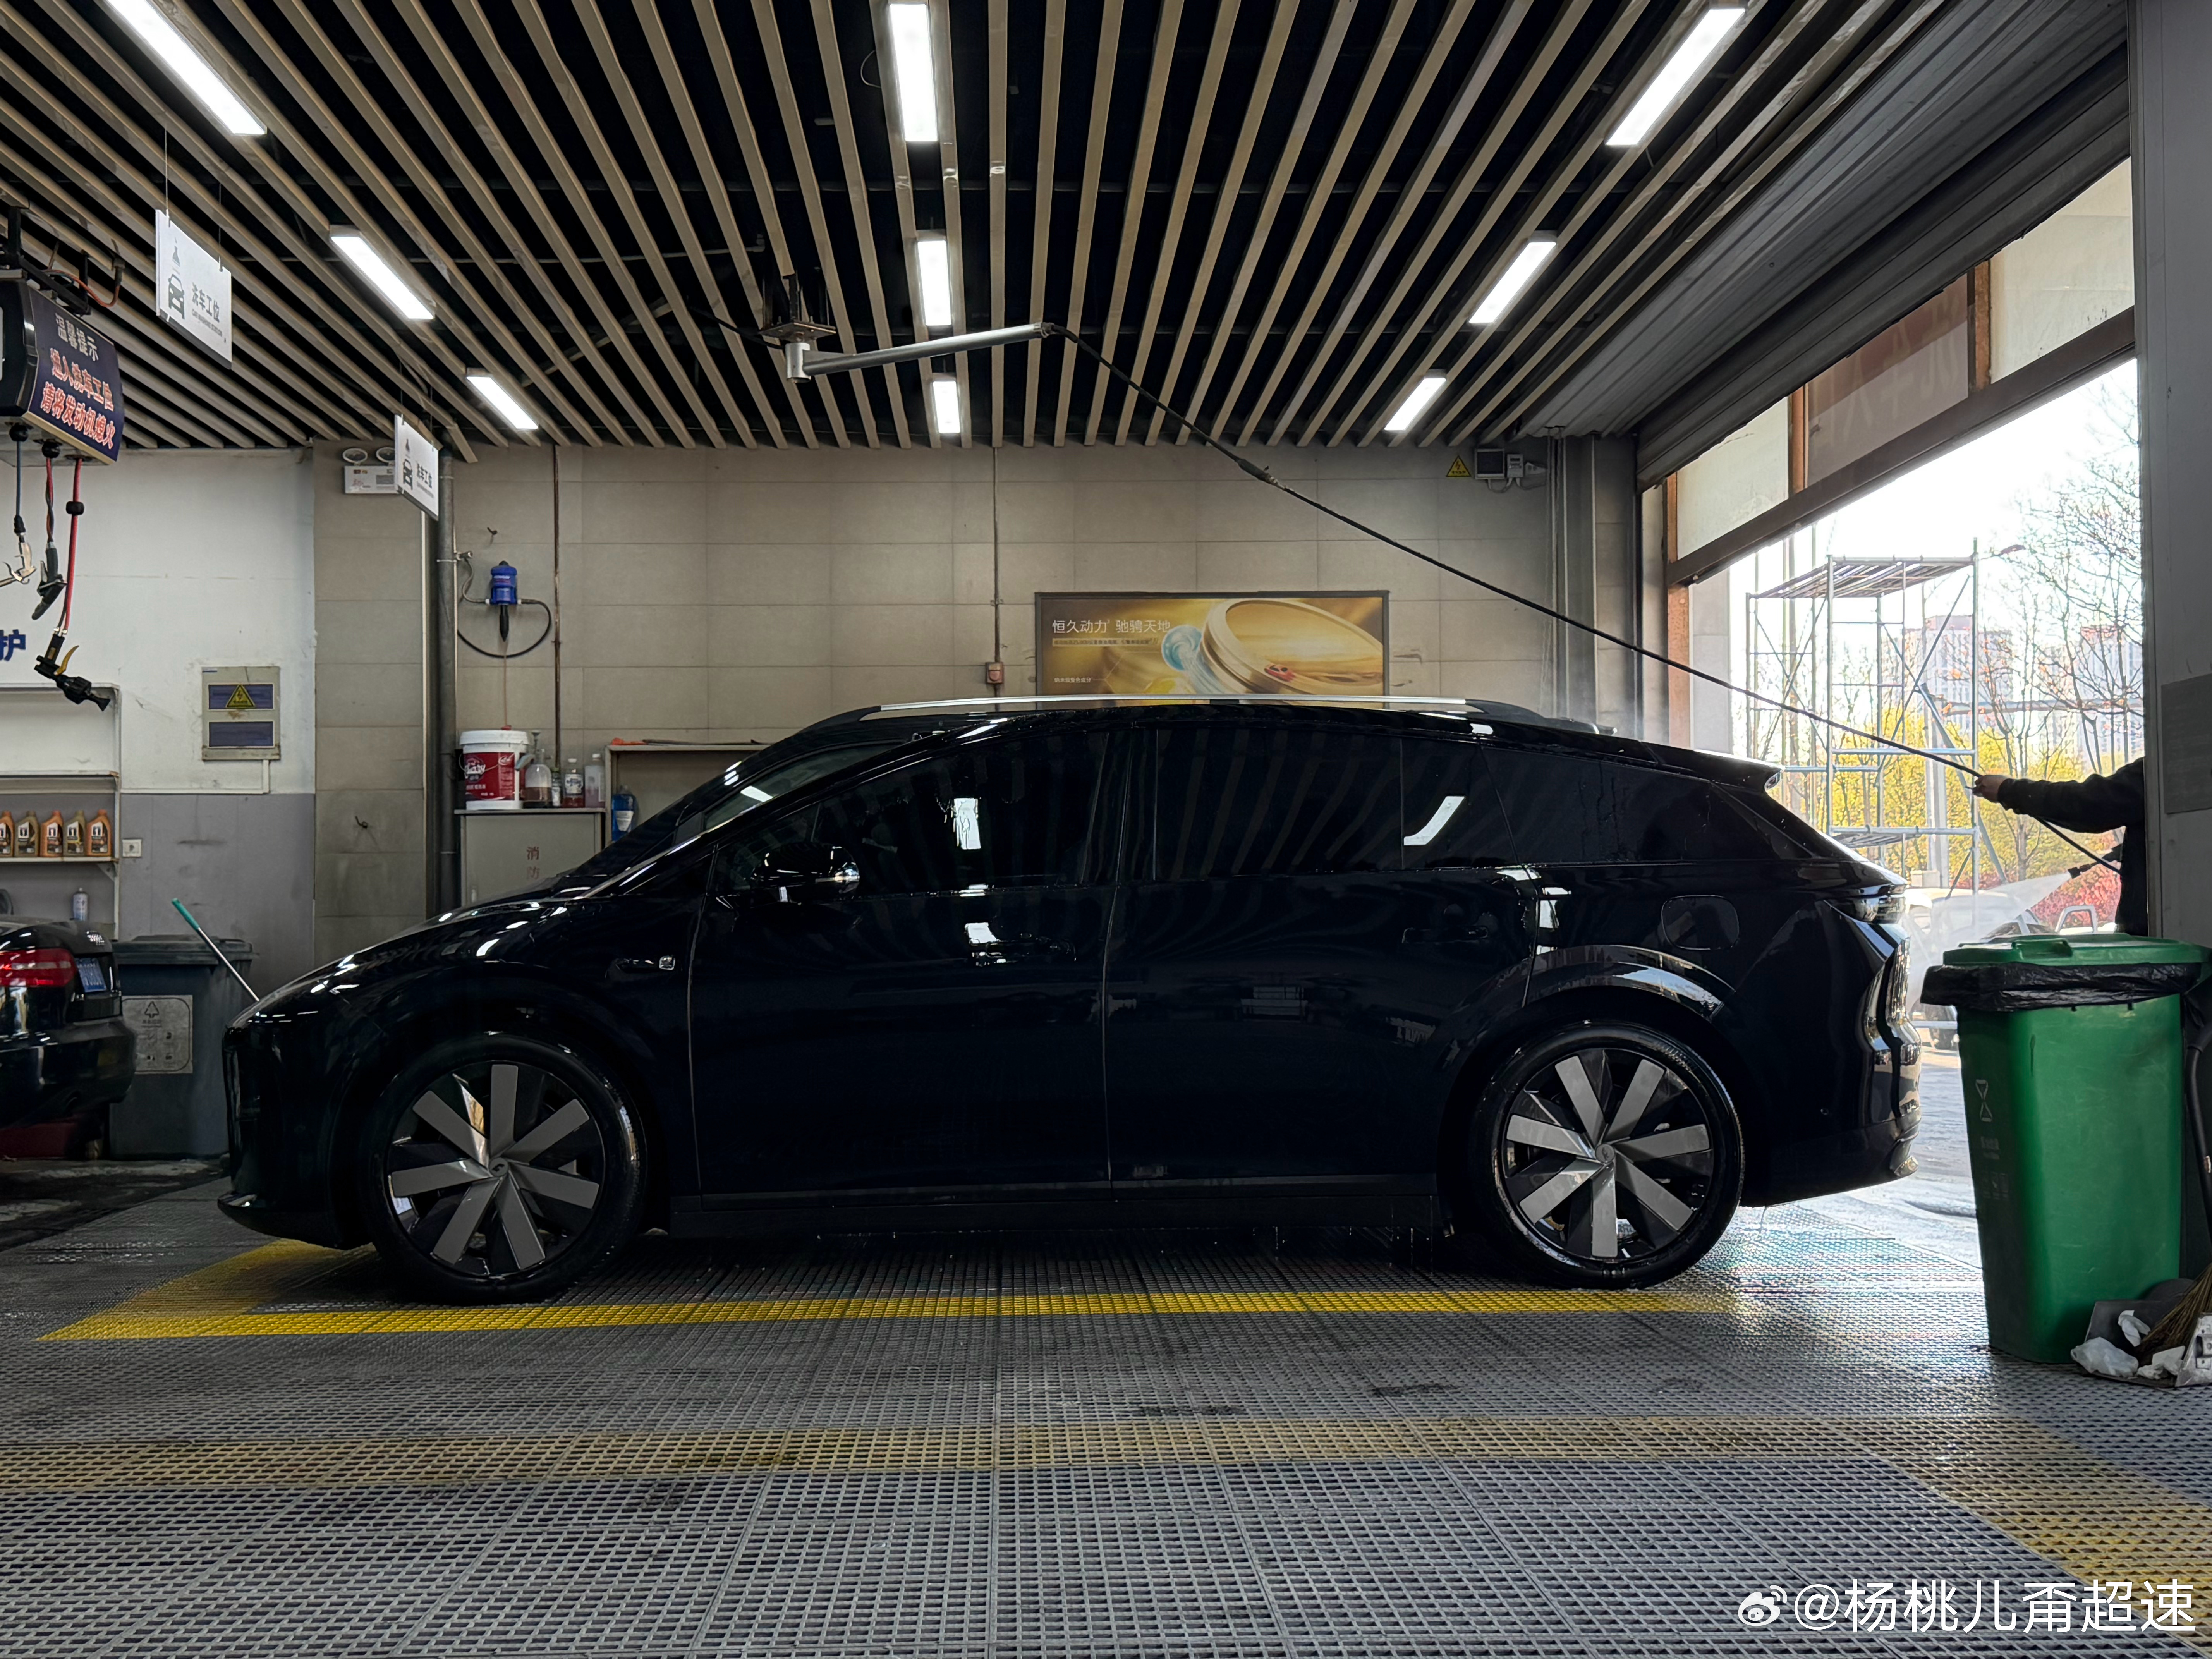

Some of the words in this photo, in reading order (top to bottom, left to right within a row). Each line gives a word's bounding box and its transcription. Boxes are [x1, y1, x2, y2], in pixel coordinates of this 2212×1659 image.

[192, 282, 220, 323] 洗车工位
[55, 313, 99, 361] 温馨提示
[50, 347, 114, 412] 进入洗车工位
[40, 381, 116, 450] 请将发动机熄火
[1115, 619, 1171, 634] 驰骋天地
